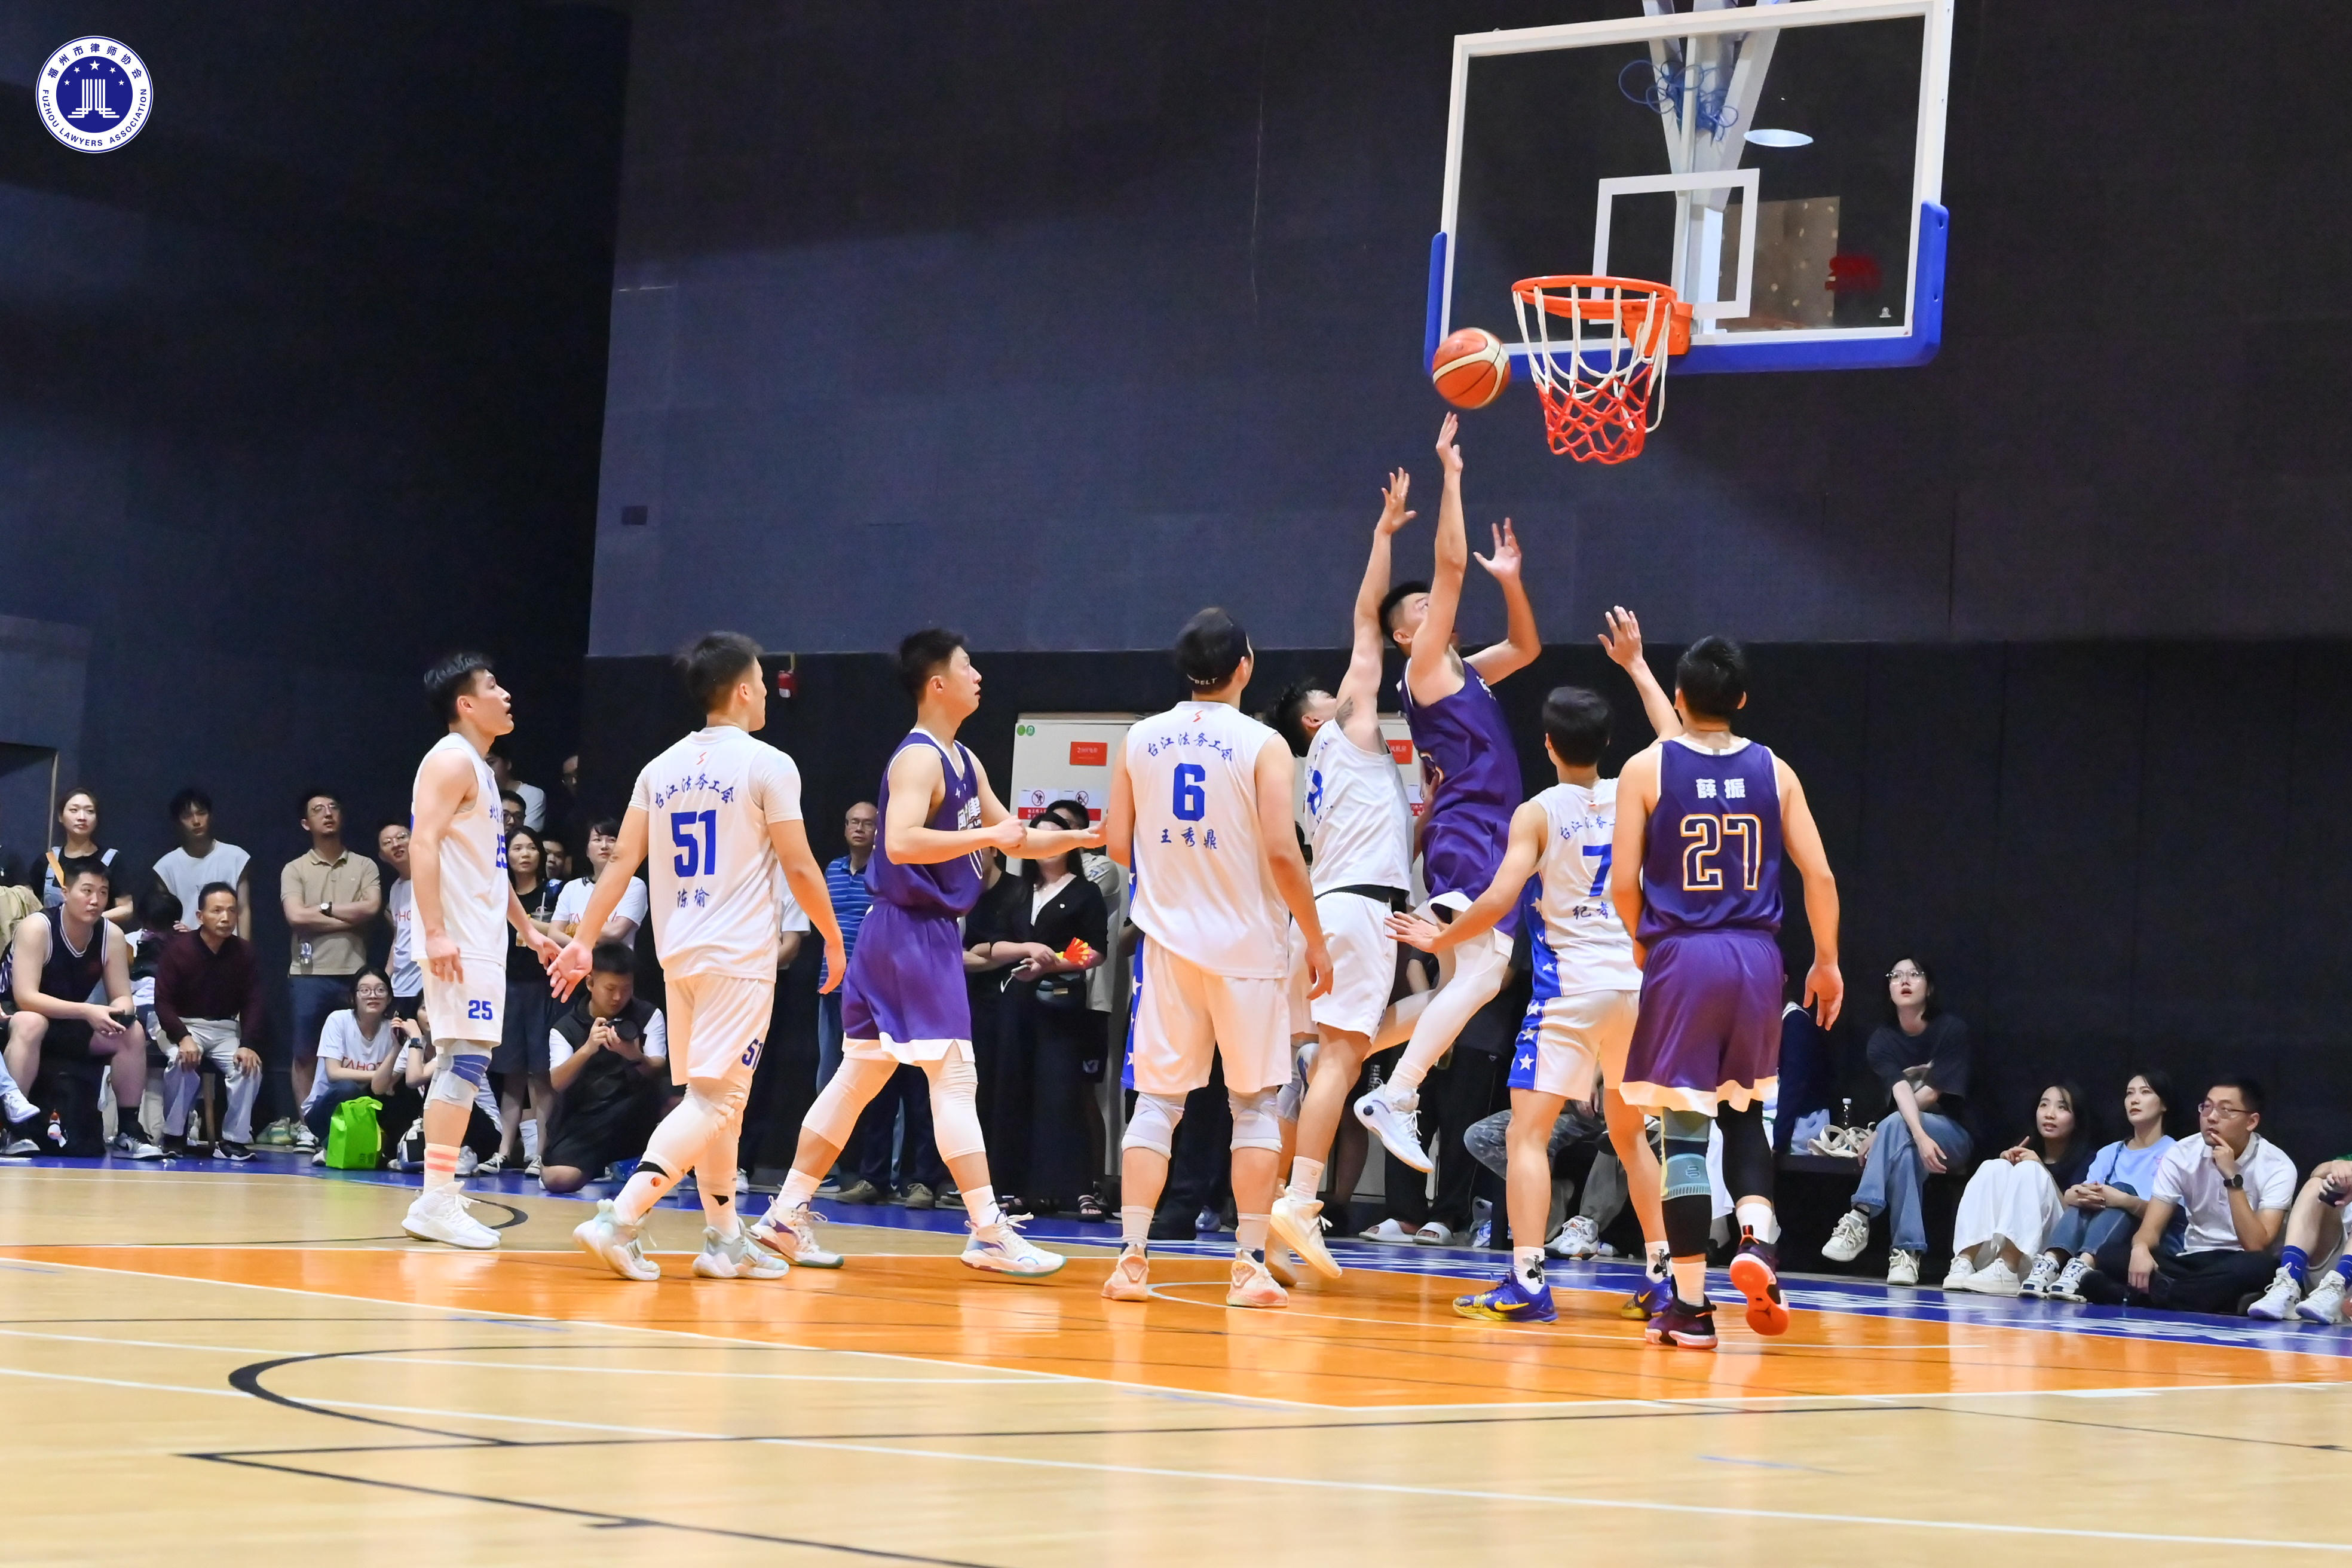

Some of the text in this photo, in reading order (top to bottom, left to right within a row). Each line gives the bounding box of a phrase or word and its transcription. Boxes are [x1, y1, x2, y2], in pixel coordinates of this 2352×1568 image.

[1147, 731, 1233, 762] 台江法务工会
[655, 773, 734, 808] 台江法务工会
[1172, 762, 1206, 822] 6
[1696, 778, 1745, 799] 薛振
[670, 809, 716, 878] 51
[1160, 826, 1217, 850] 王秀鼎
[1680, 813, 1762, 891] 27
[1582, 843, 1612, 897] 7
[677, 886, 710, 908] 陈瑜
[468, 999, 493, 1021] 25
[742, 1038, 764, 1070] 51
